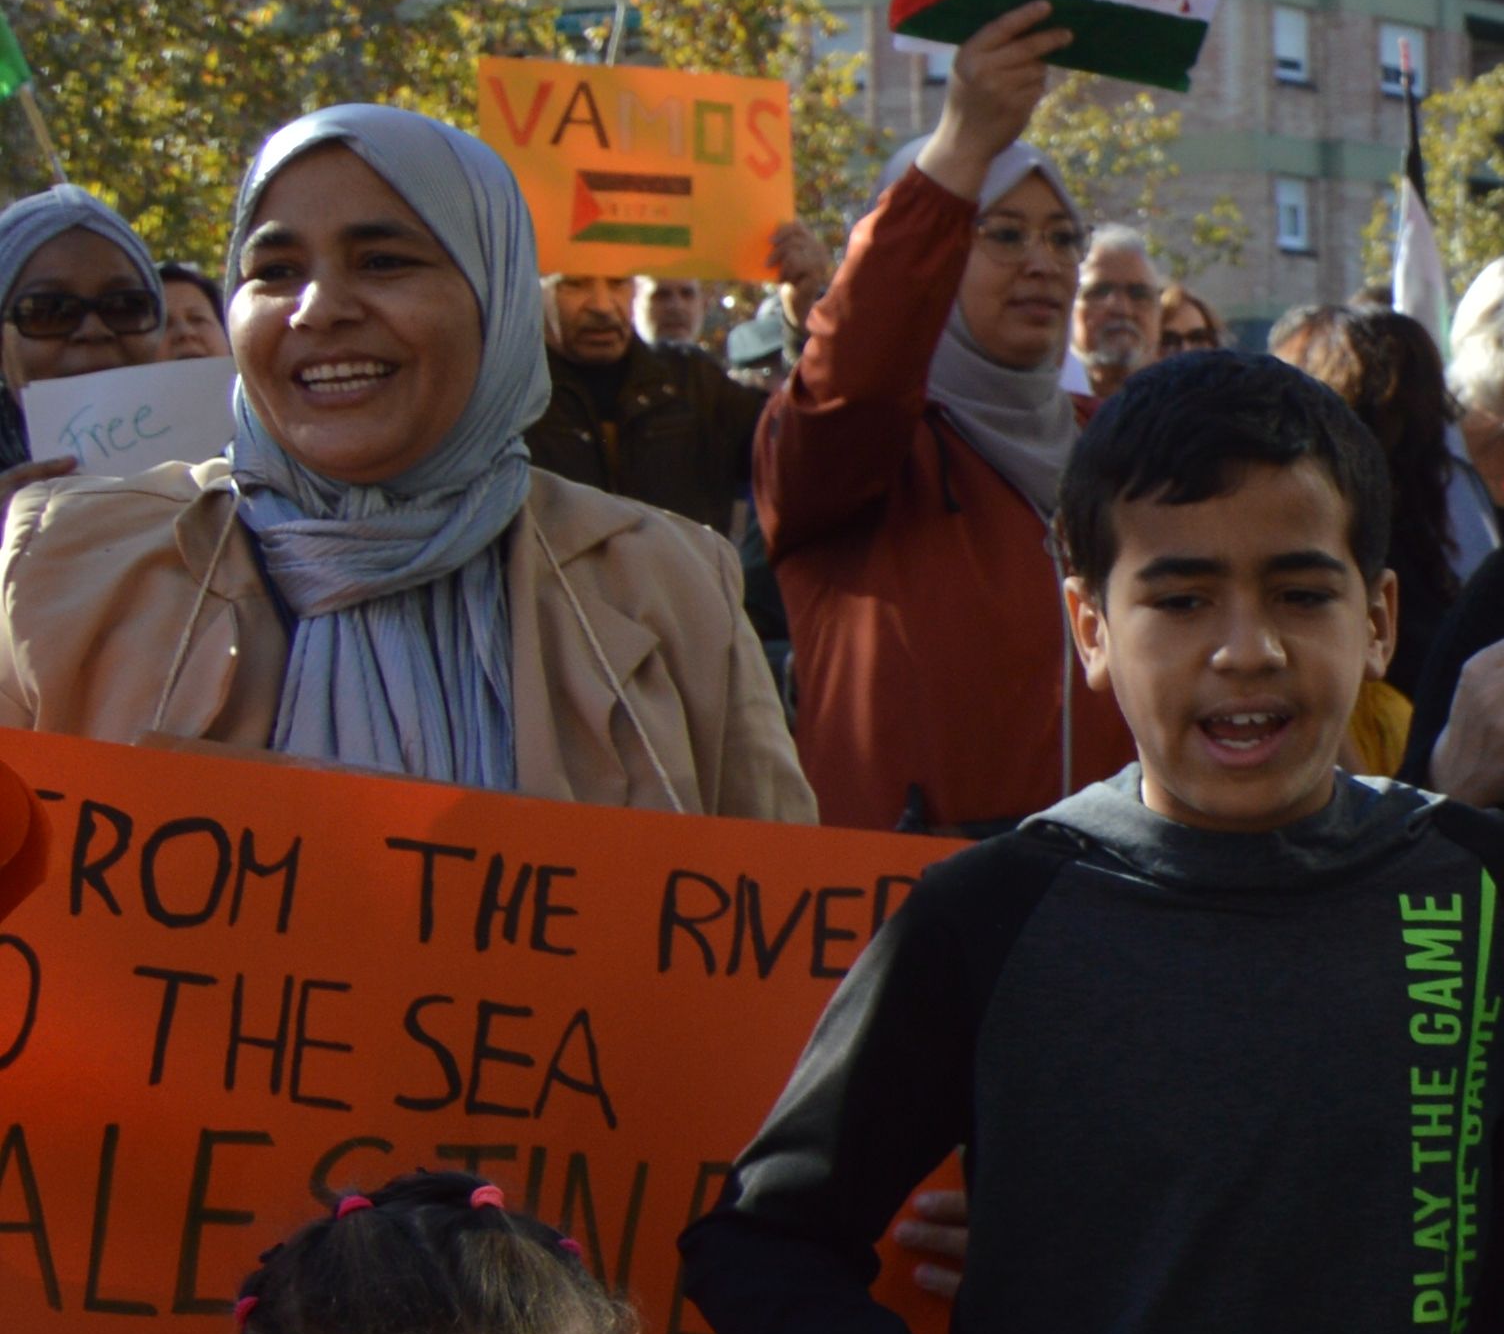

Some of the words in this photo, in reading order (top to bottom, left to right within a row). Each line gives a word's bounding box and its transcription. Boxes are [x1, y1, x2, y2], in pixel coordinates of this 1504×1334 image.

[486, 73, 784, 181] VAMOS
[58, 402, 173, 467] Free
[385, 836, 578, 957] THE
[1398, 893, 1464, 1045] GAME
[133, 965, 354, 1112] THE
[393, 993, 619, 1130] SEA
[1410, 1066, 1459, 1173] THE
